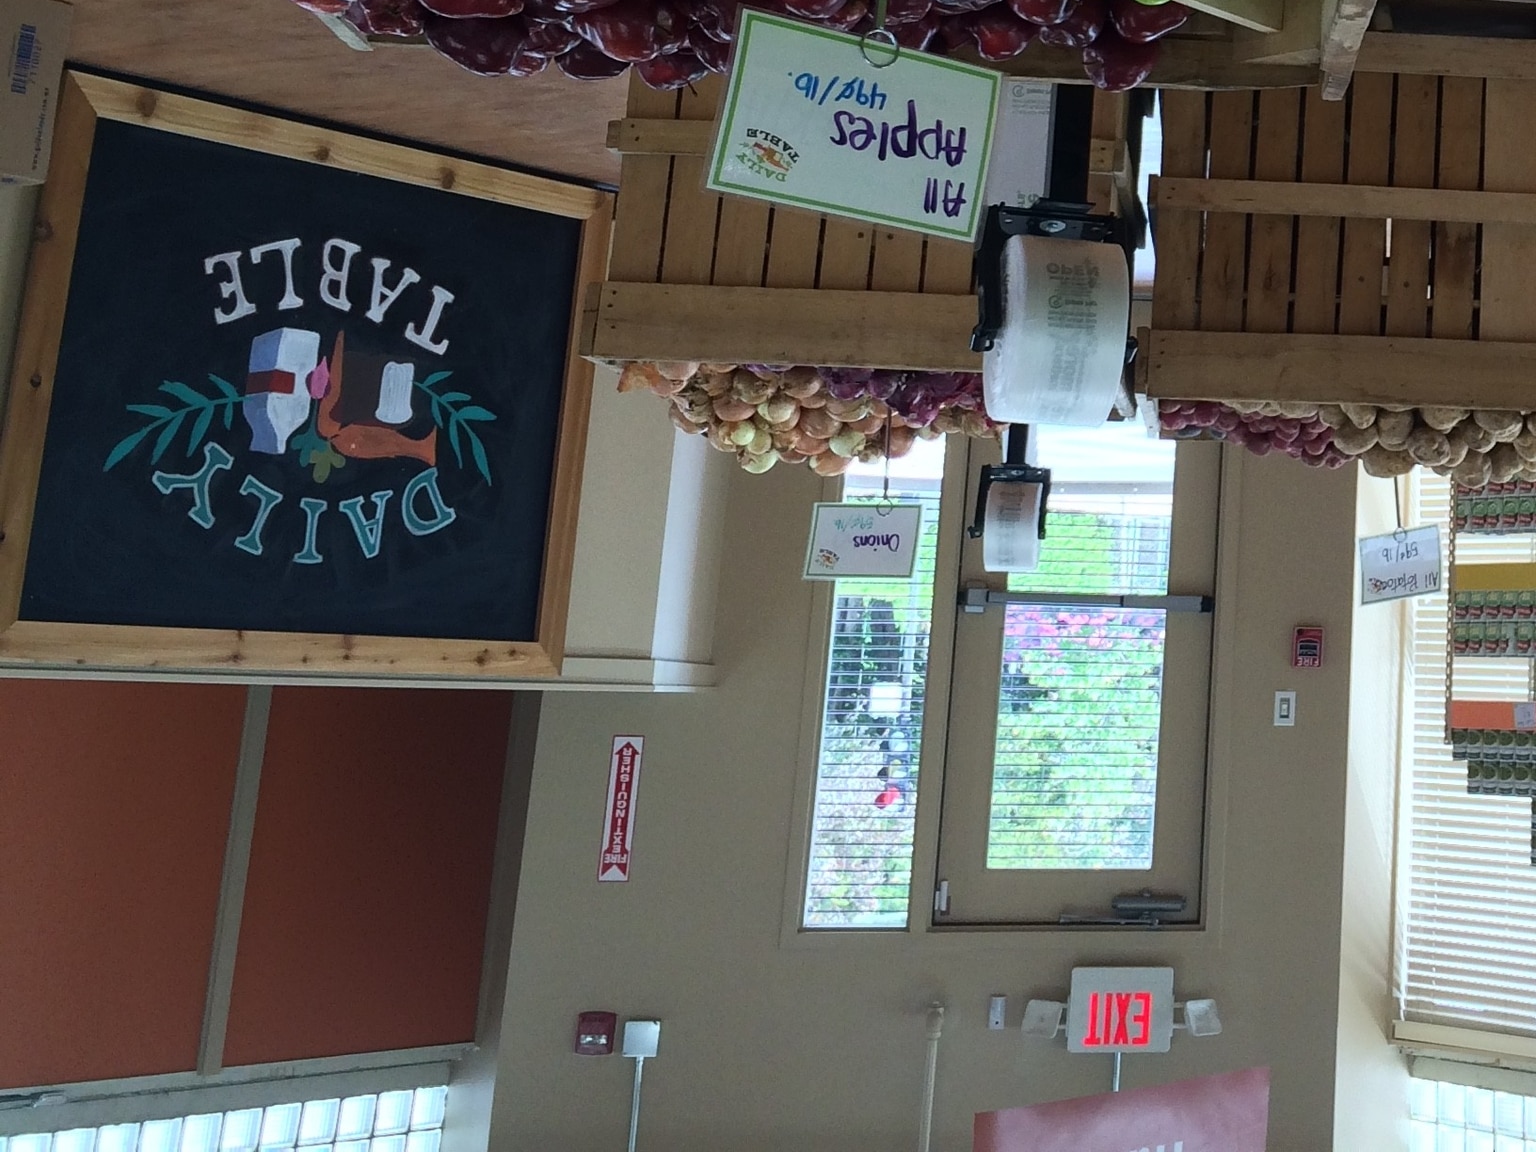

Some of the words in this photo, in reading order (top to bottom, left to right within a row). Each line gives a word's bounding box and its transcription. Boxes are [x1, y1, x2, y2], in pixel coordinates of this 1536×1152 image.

[746, 128, 800, 164] TABLE
[829, 99, 967, 168] Apples
[736, 152, 787, 183] DAILY
[923, 177, 967, 218] All
[203, 237, 455, 356] TABLE
[151, 441, 457, 564] DAILY
[853, 533, 900, 552] Onions
[1424, 572, 1439, 588] All
[1296, 657, 1320, 667] FIRE
[611, 748, 632, 854] EXTINGUISHER
[603, 853, 627, 864] FIRE
[1083, 992, 1152, 1046] EXIT
